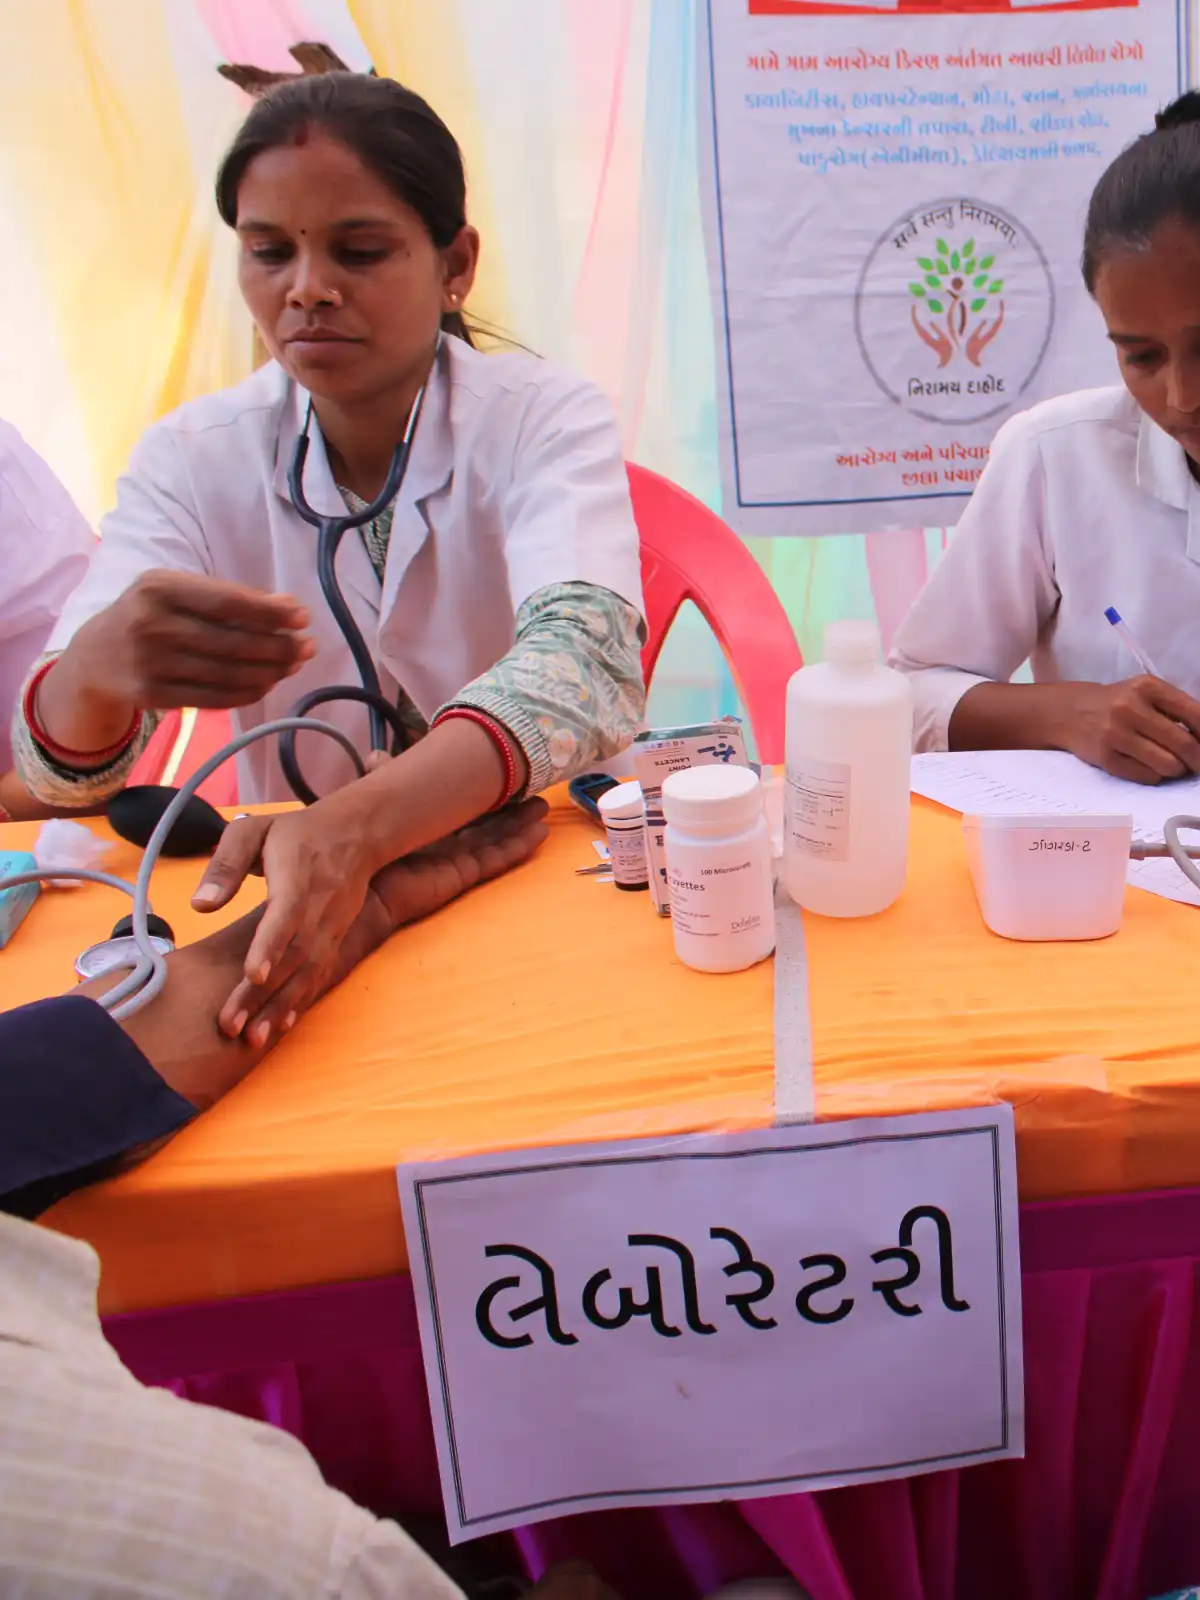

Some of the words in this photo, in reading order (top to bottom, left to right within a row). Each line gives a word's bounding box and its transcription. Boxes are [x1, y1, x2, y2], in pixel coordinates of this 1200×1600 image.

[908, 377, 961, 396] નિરામય
[967, 374, 1006, 394] દાહોદ
[836, 447, 897, 468] આરોગ્ય
[902, 444, 933, 464] અને
[939, 441, 991, 462] પરિવા
[475, 1205, 971, 1349] લેબોરેટરી
